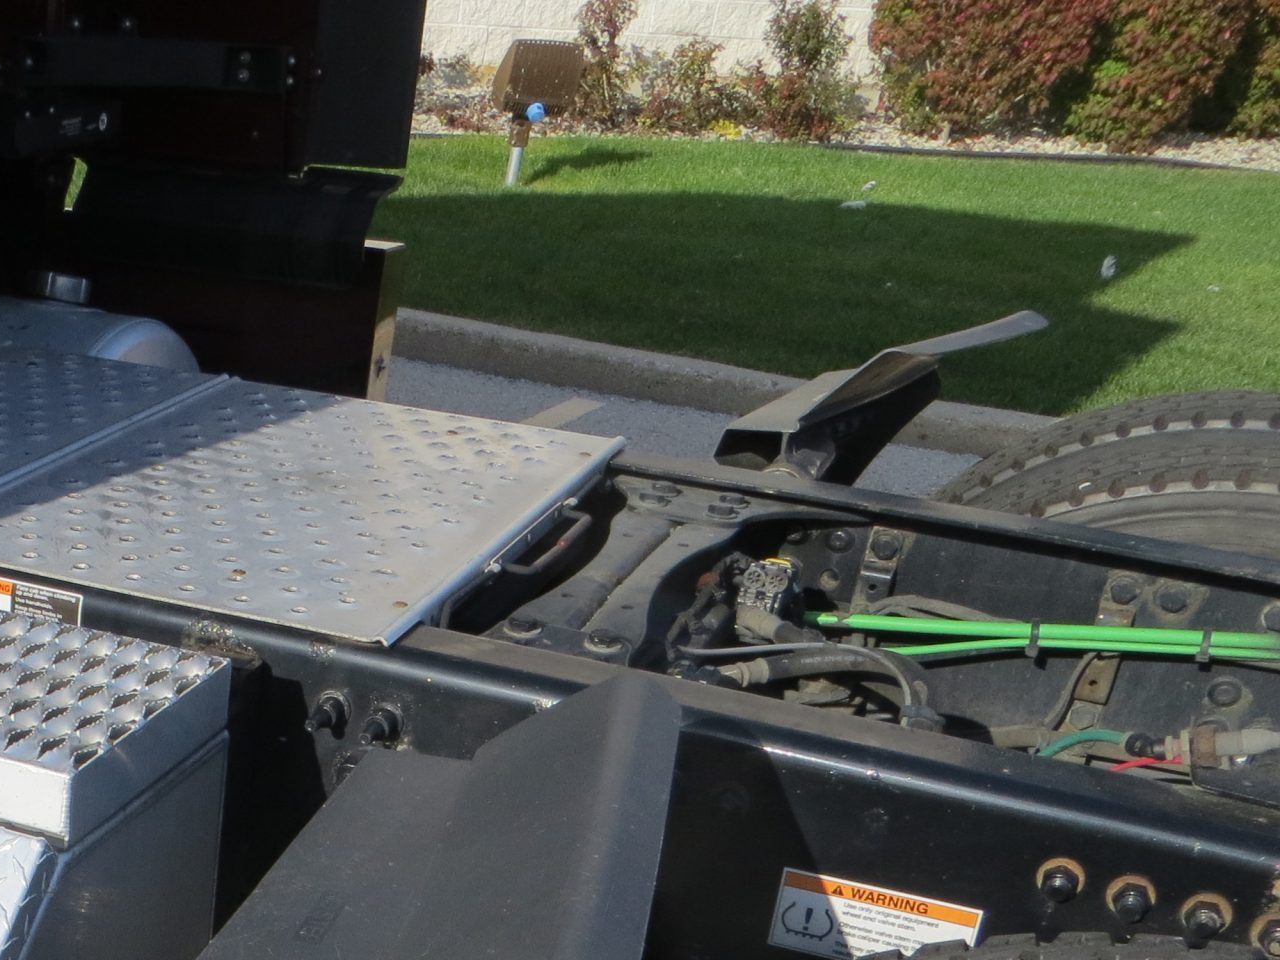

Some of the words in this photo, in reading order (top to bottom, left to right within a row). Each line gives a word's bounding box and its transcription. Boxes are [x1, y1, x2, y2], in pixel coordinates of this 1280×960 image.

[851, 887, 929, 915] WARNING
[841, 909, 861, 919] wheel
[862, 914, 876, 922] and
[877, 917, 896, 927] valve
[843, 901, 857, 910] Use
[857, 904, 872, 914] only
[874, 908, 901, 921] original
[901, 914, 939, 930] equipment
[837, 921, 873, 935] Otherwise
[873, 929, 893, 939] valve
[893, 934, 909, 942] stem
[856, 932, 880, 944] caliper
[881, 939, 909, 951] causing
